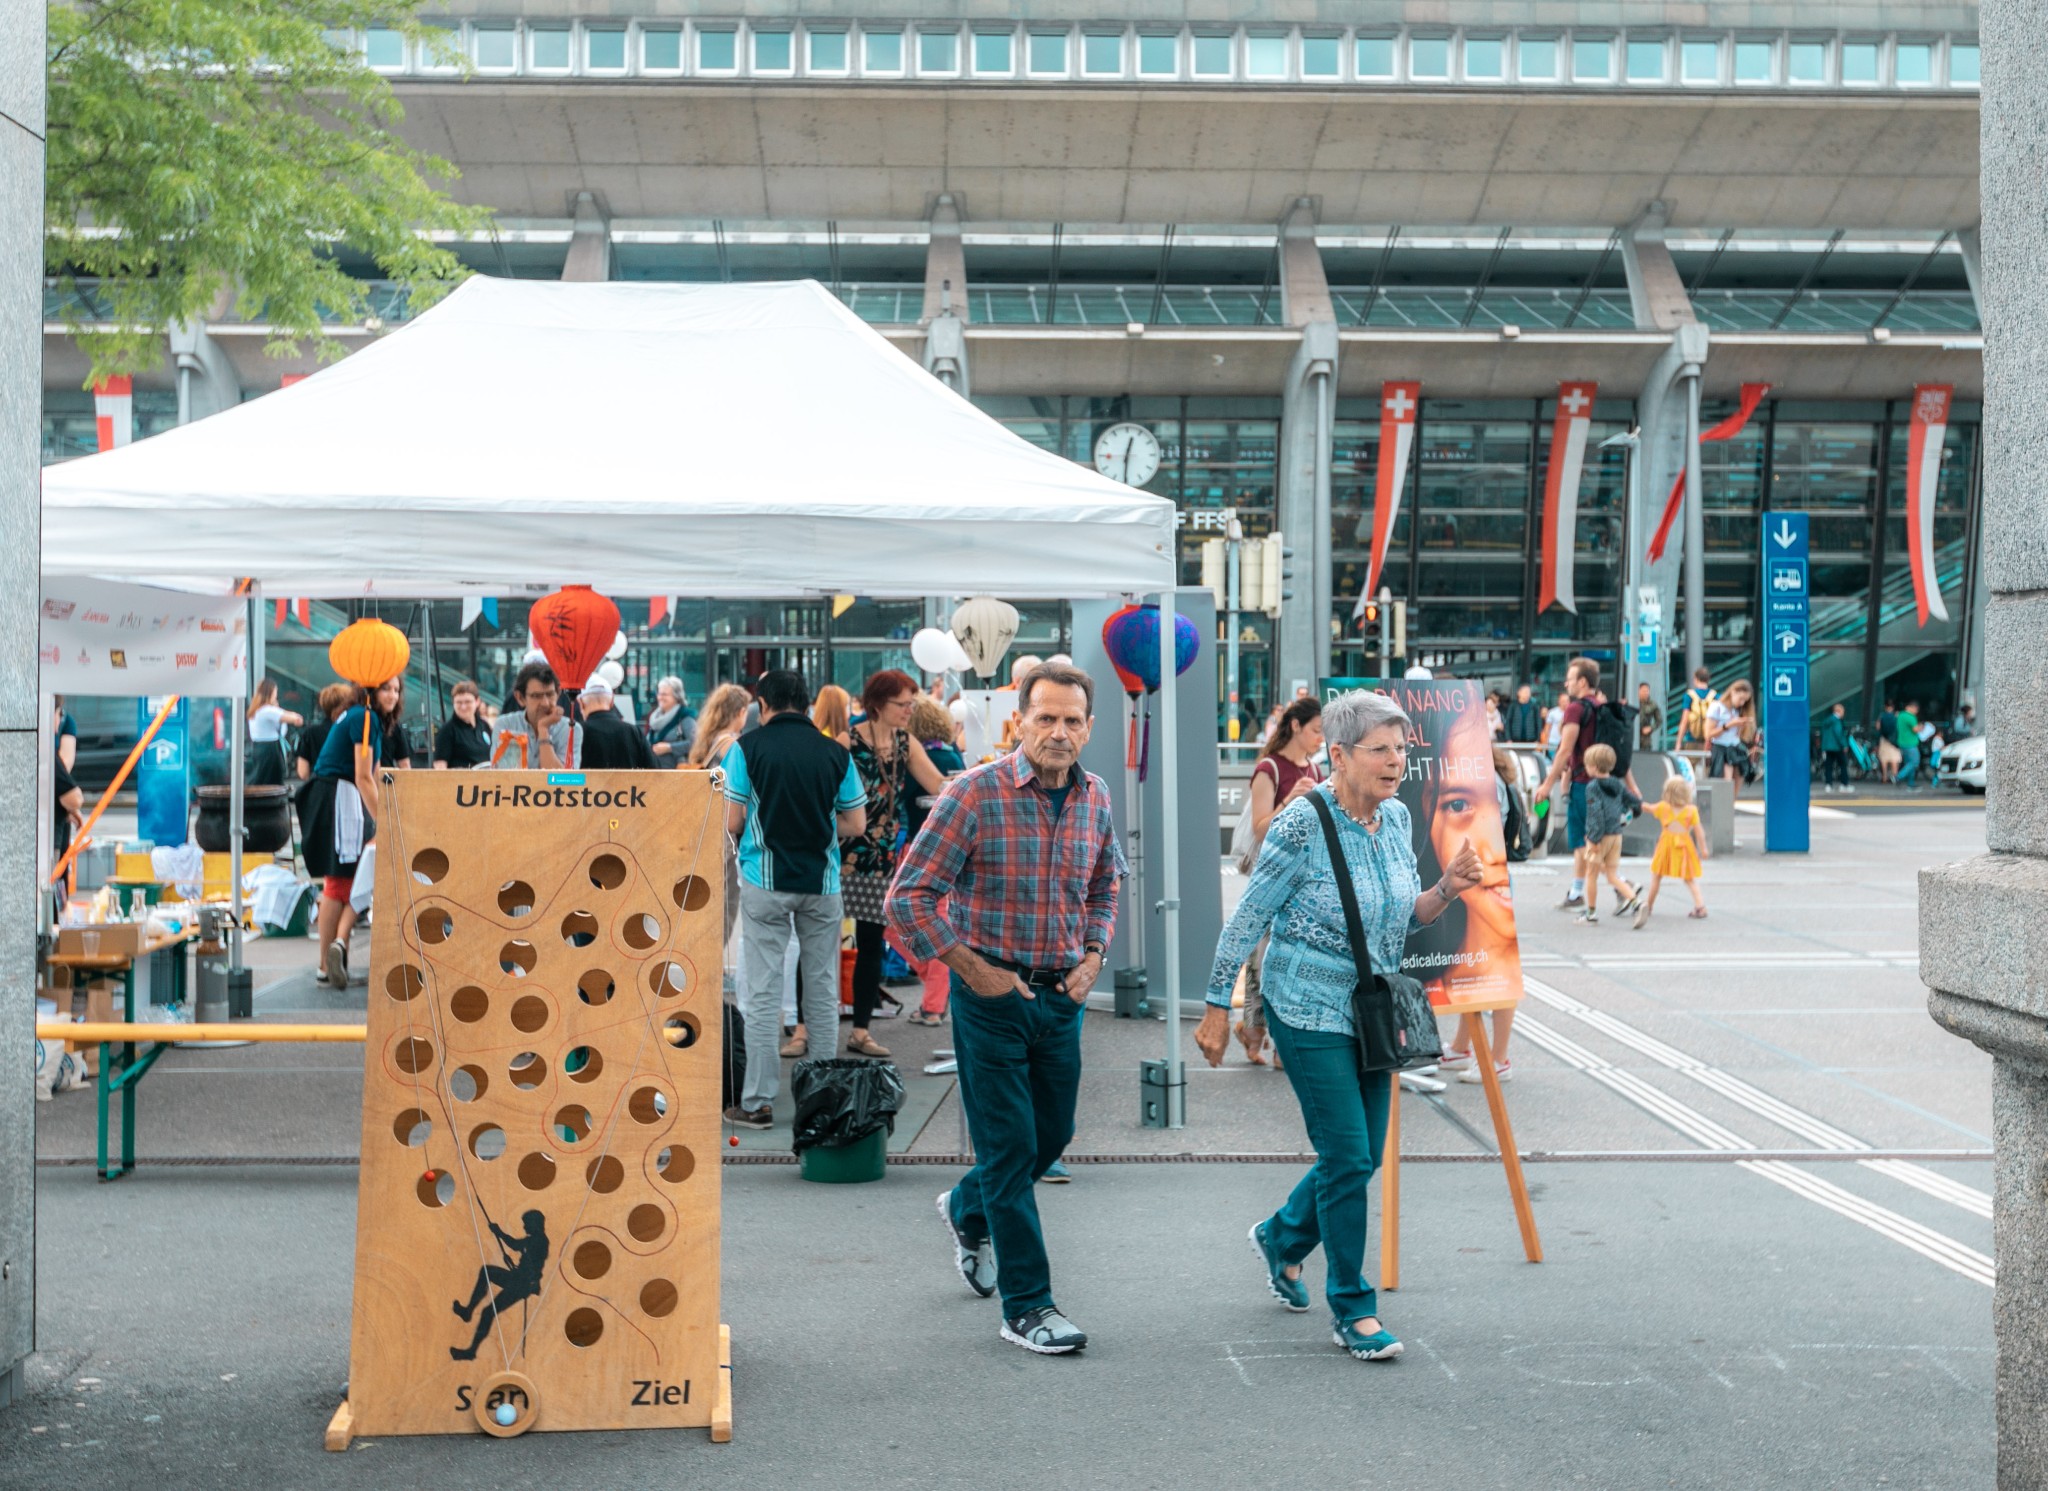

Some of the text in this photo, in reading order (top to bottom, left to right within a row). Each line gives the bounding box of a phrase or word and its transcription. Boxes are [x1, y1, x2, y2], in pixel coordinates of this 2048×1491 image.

[1406, 688, 1466, 713] NANG
[1439, 756, 1487, 781] IHRE
[456, 784, 647, 808] Uri-Rotstock
[1400, 948, 1489, 970] edicaldanang.ch
[631, 1379, 691, 1406] Ziel
